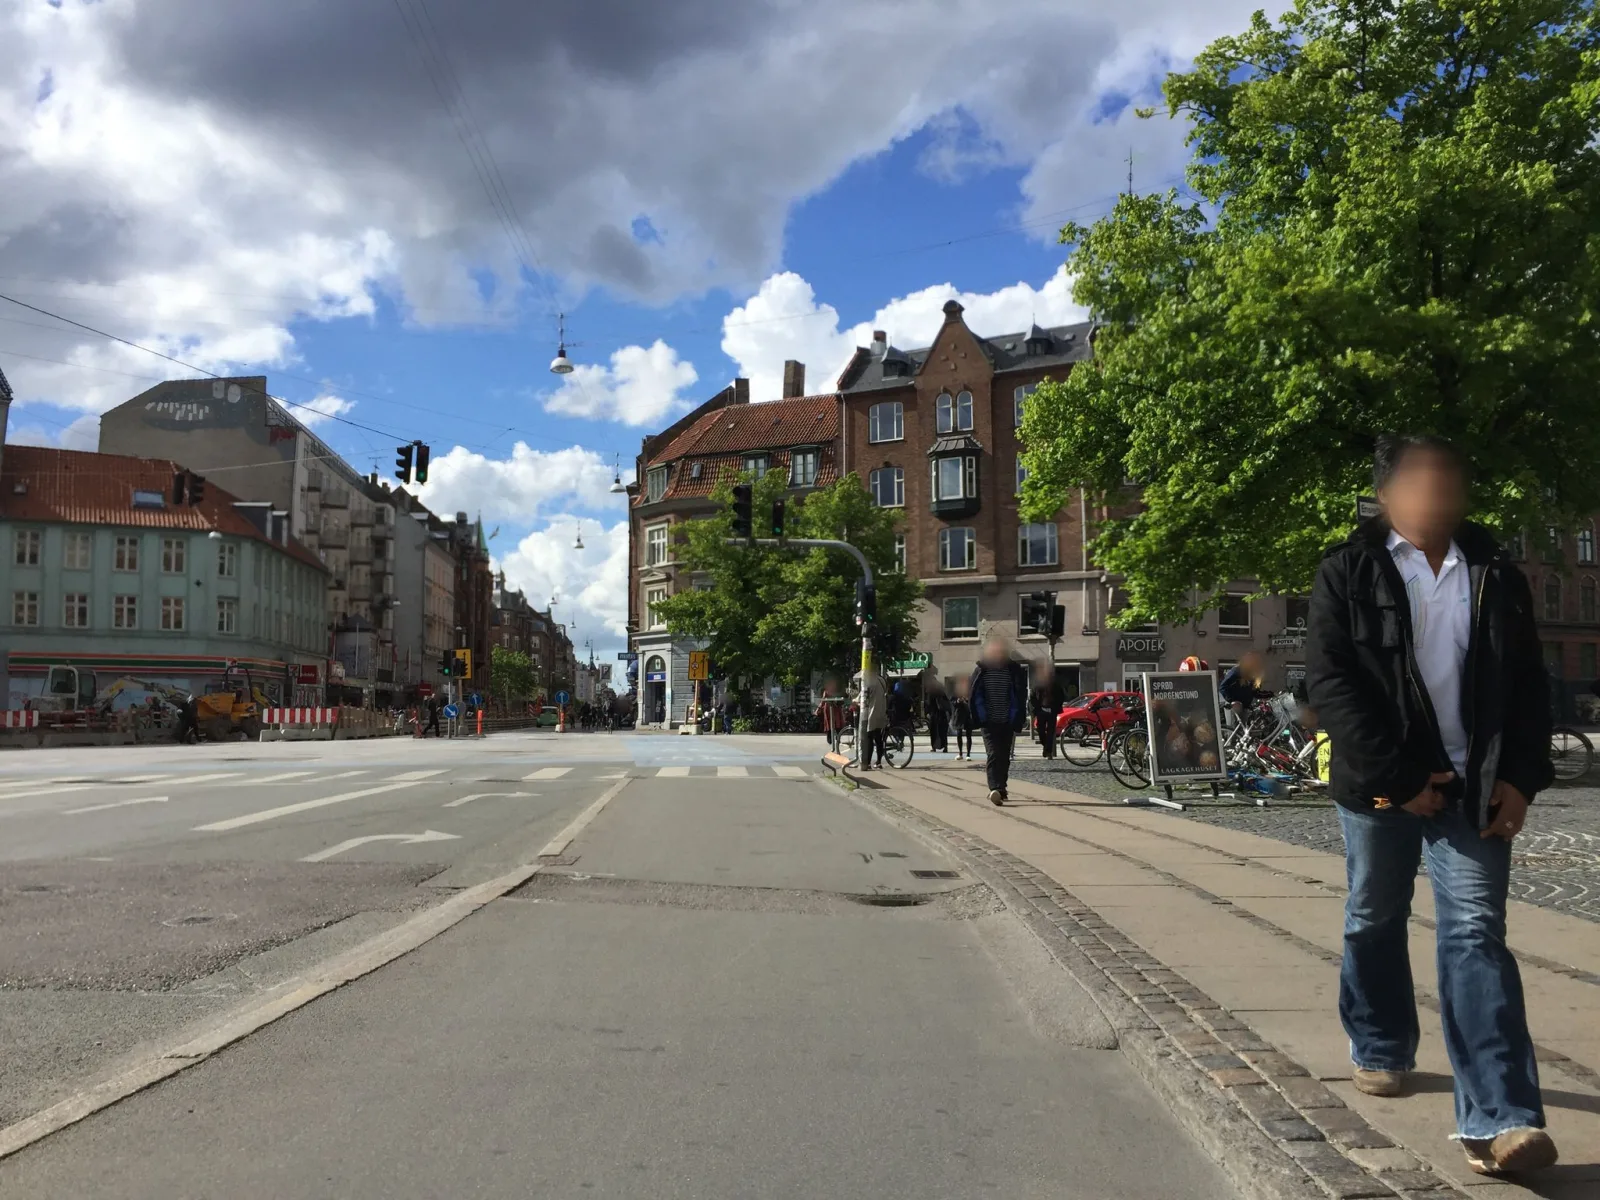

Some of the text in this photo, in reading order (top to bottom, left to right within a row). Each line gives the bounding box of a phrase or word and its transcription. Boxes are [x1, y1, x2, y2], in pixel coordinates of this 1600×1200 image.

[1118, 639, 1165, 652] APOTEK
[1152, 681, 1174, 690] SPRØD
[1153, 690, 1199, 700] MORGENSTUND
[1160, 765, 1218, 774] LAGKAGEHUSET
